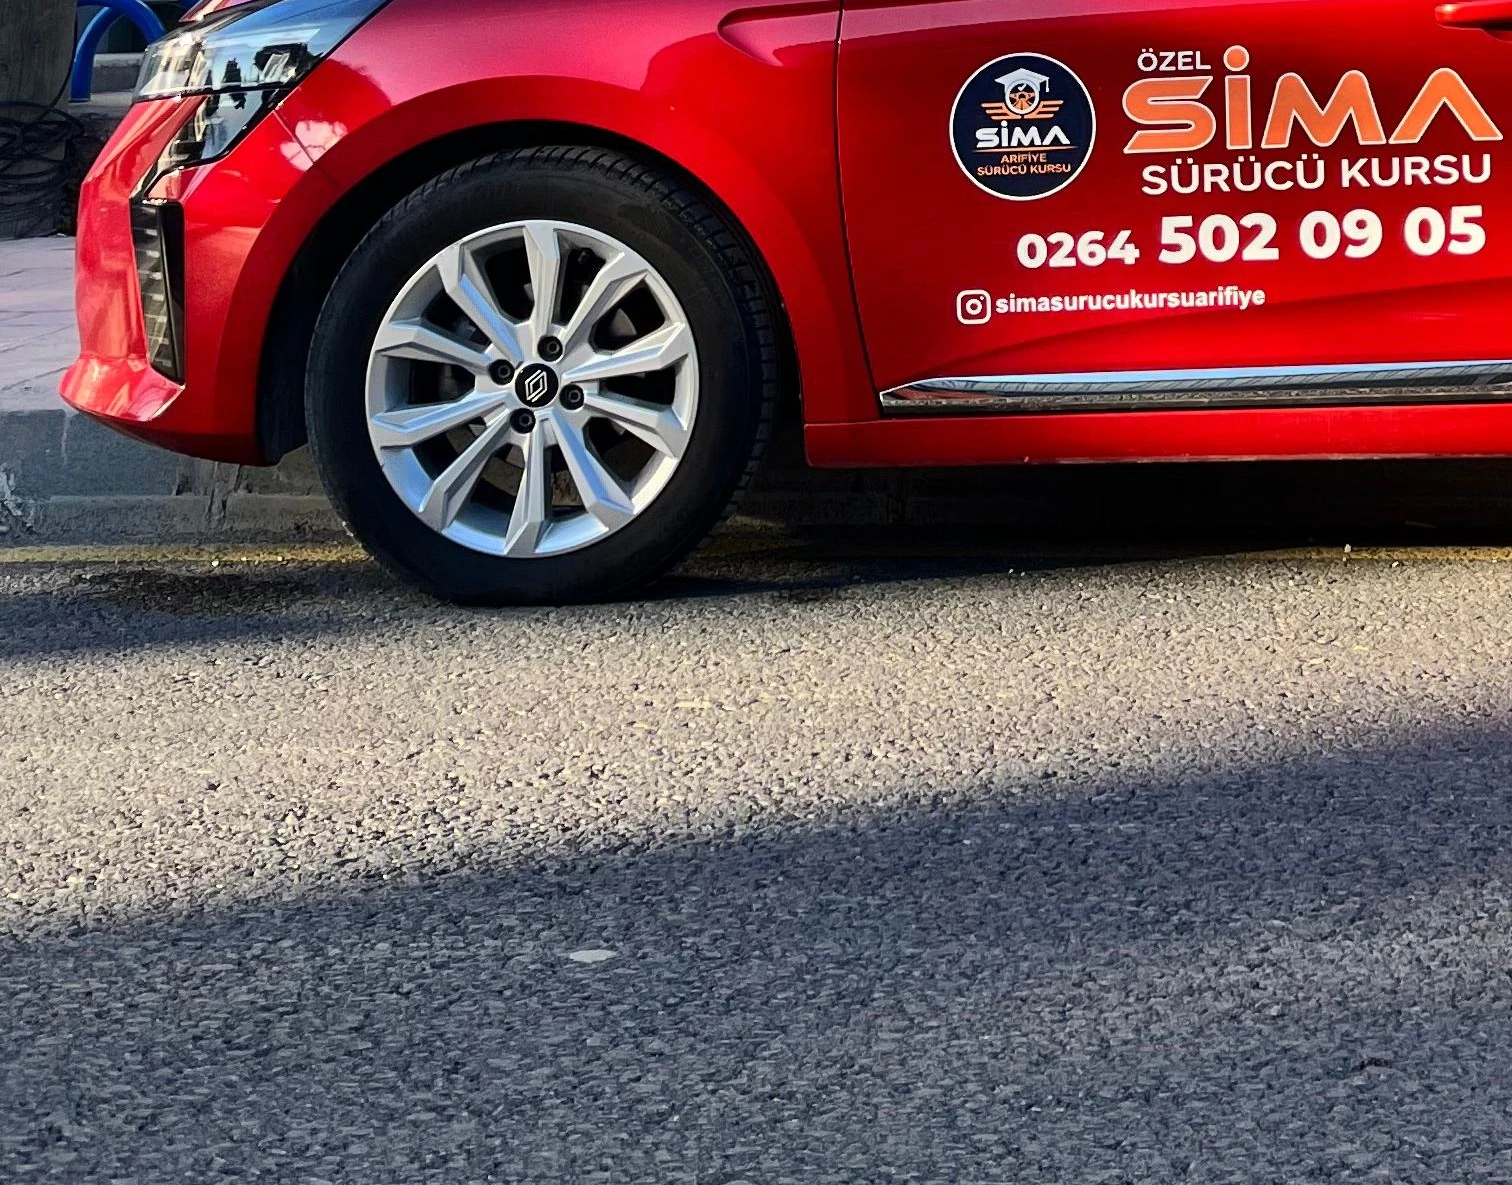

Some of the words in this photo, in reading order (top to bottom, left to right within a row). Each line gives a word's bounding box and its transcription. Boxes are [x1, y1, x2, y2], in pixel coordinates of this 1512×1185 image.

[1137, 48, 1212, 71] ÖZEL
[1122, 45, 1504, 154] SİMA
[975, 120, 1071, 148] SİMA
[977, 164, 1027, 176] SÜRÜCÜ
[1030, 163, 1072, 174] KURSU
[1000, 152, 1048, 164] ARİFİYE
[1141, 156, 1326, 196] SÜRÜCÜ
[1341, 154, 1492, 190] KURSU
[1016, 230, 1140, 269] 0264
[1158, 213, 1280, 263] 502
[1299, 209, 1383, 259] 09
[1403, 205, 1487, 256] 05
[995, 286, 1266, 314] simasurucukursuarifiye
